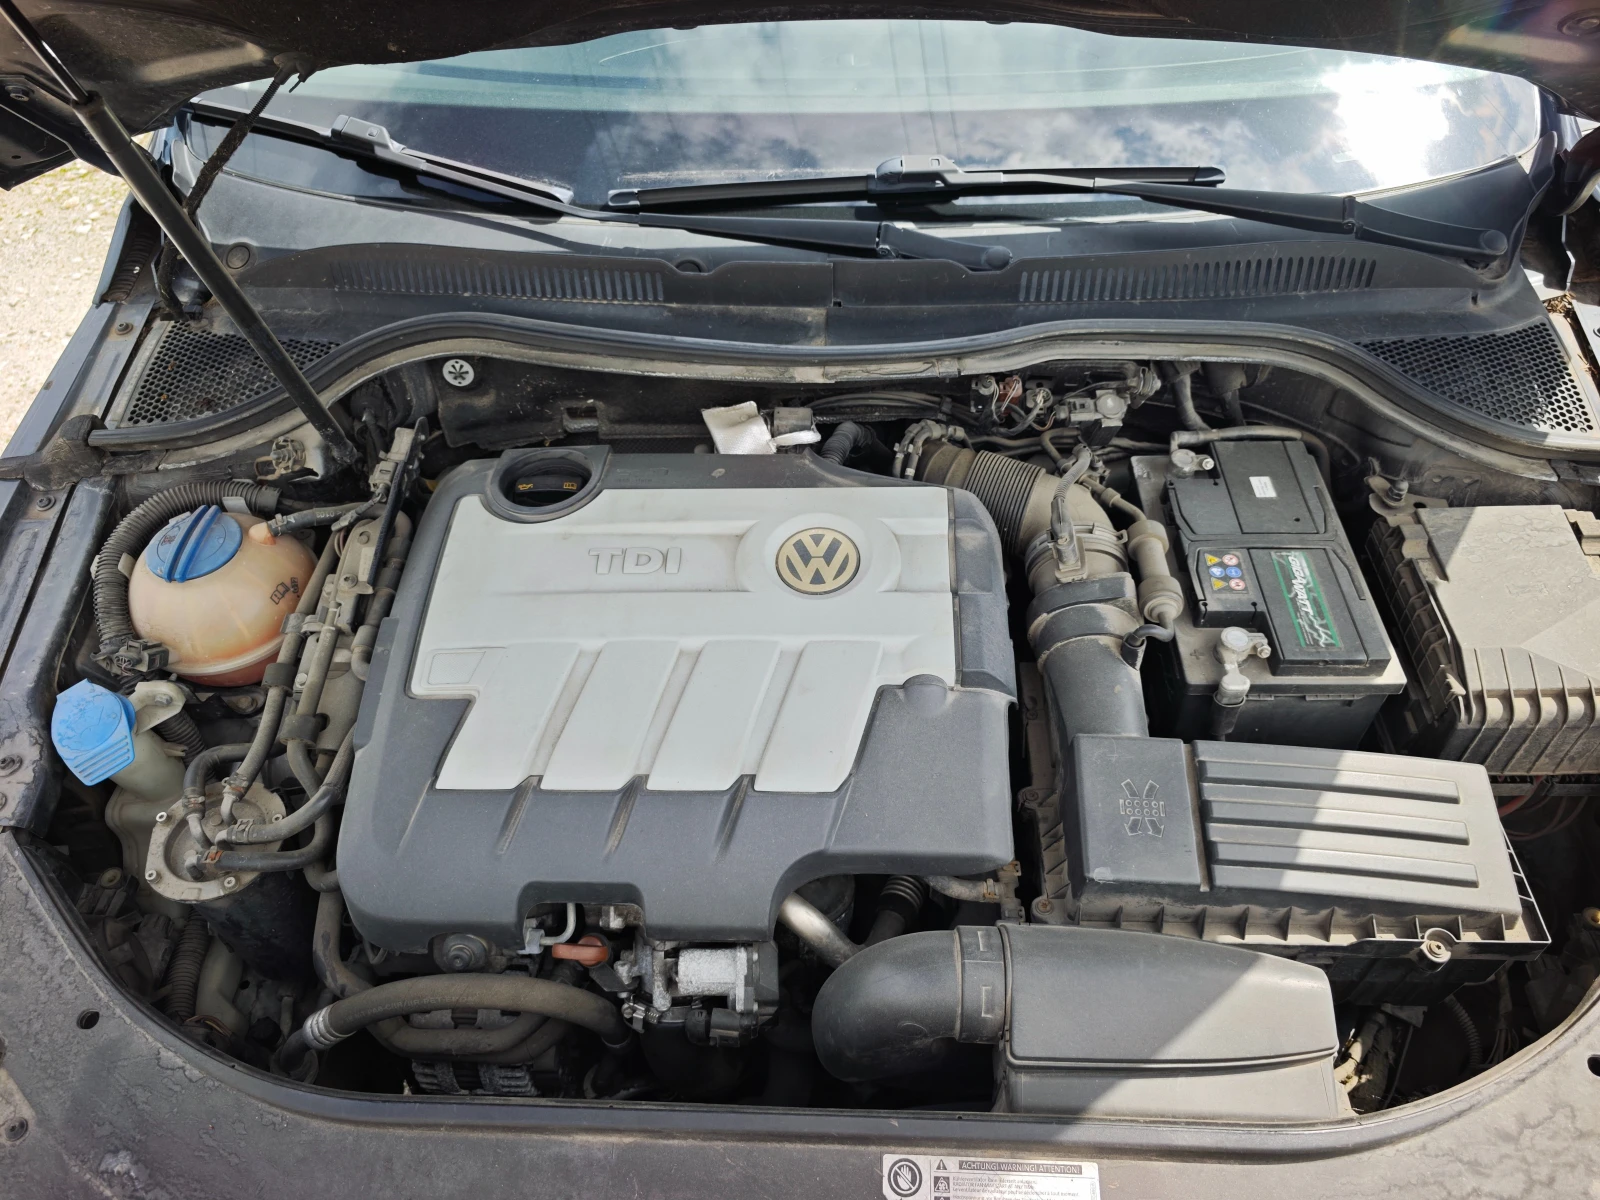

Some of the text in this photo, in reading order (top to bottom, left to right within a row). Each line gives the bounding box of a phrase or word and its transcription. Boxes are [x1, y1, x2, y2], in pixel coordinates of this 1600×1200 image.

[588, 547, 682, 575] TDI
[778, 529, 858, 593] VW
[1288, 556, 1314, 616] GIGAWATT
[961, 1161, 1080, 1174] ACHTUNG! WARNING! ATTENTION!
